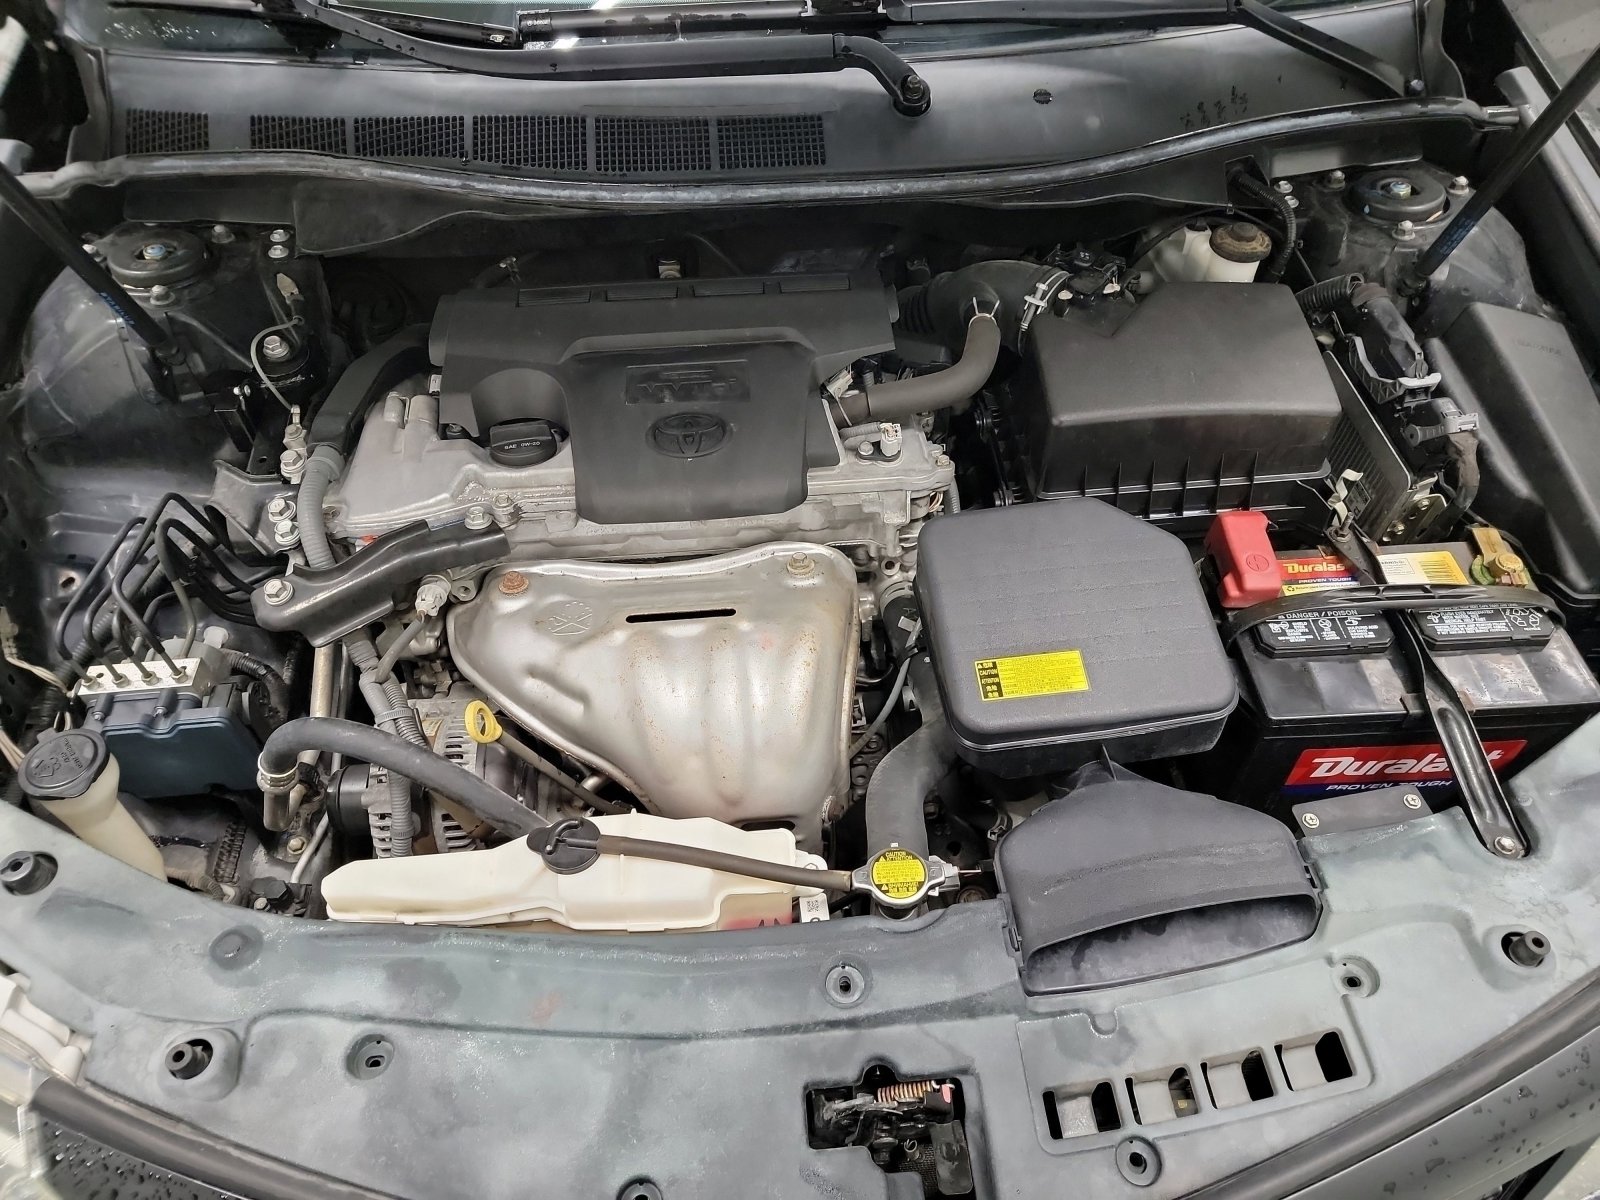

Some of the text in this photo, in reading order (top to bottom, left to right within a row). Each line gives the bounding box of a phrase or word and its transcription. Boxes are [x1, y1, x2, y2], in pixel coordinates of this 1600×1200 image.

[1283, 561, 1345, 574] Duralas
[1286, 611, 1320, 620] DANGER
[1327, 609, 1358, 617] POISON
[979, 668, 998, 676] CAUTION
[1326, 782, 1394, 791] PROVEN
